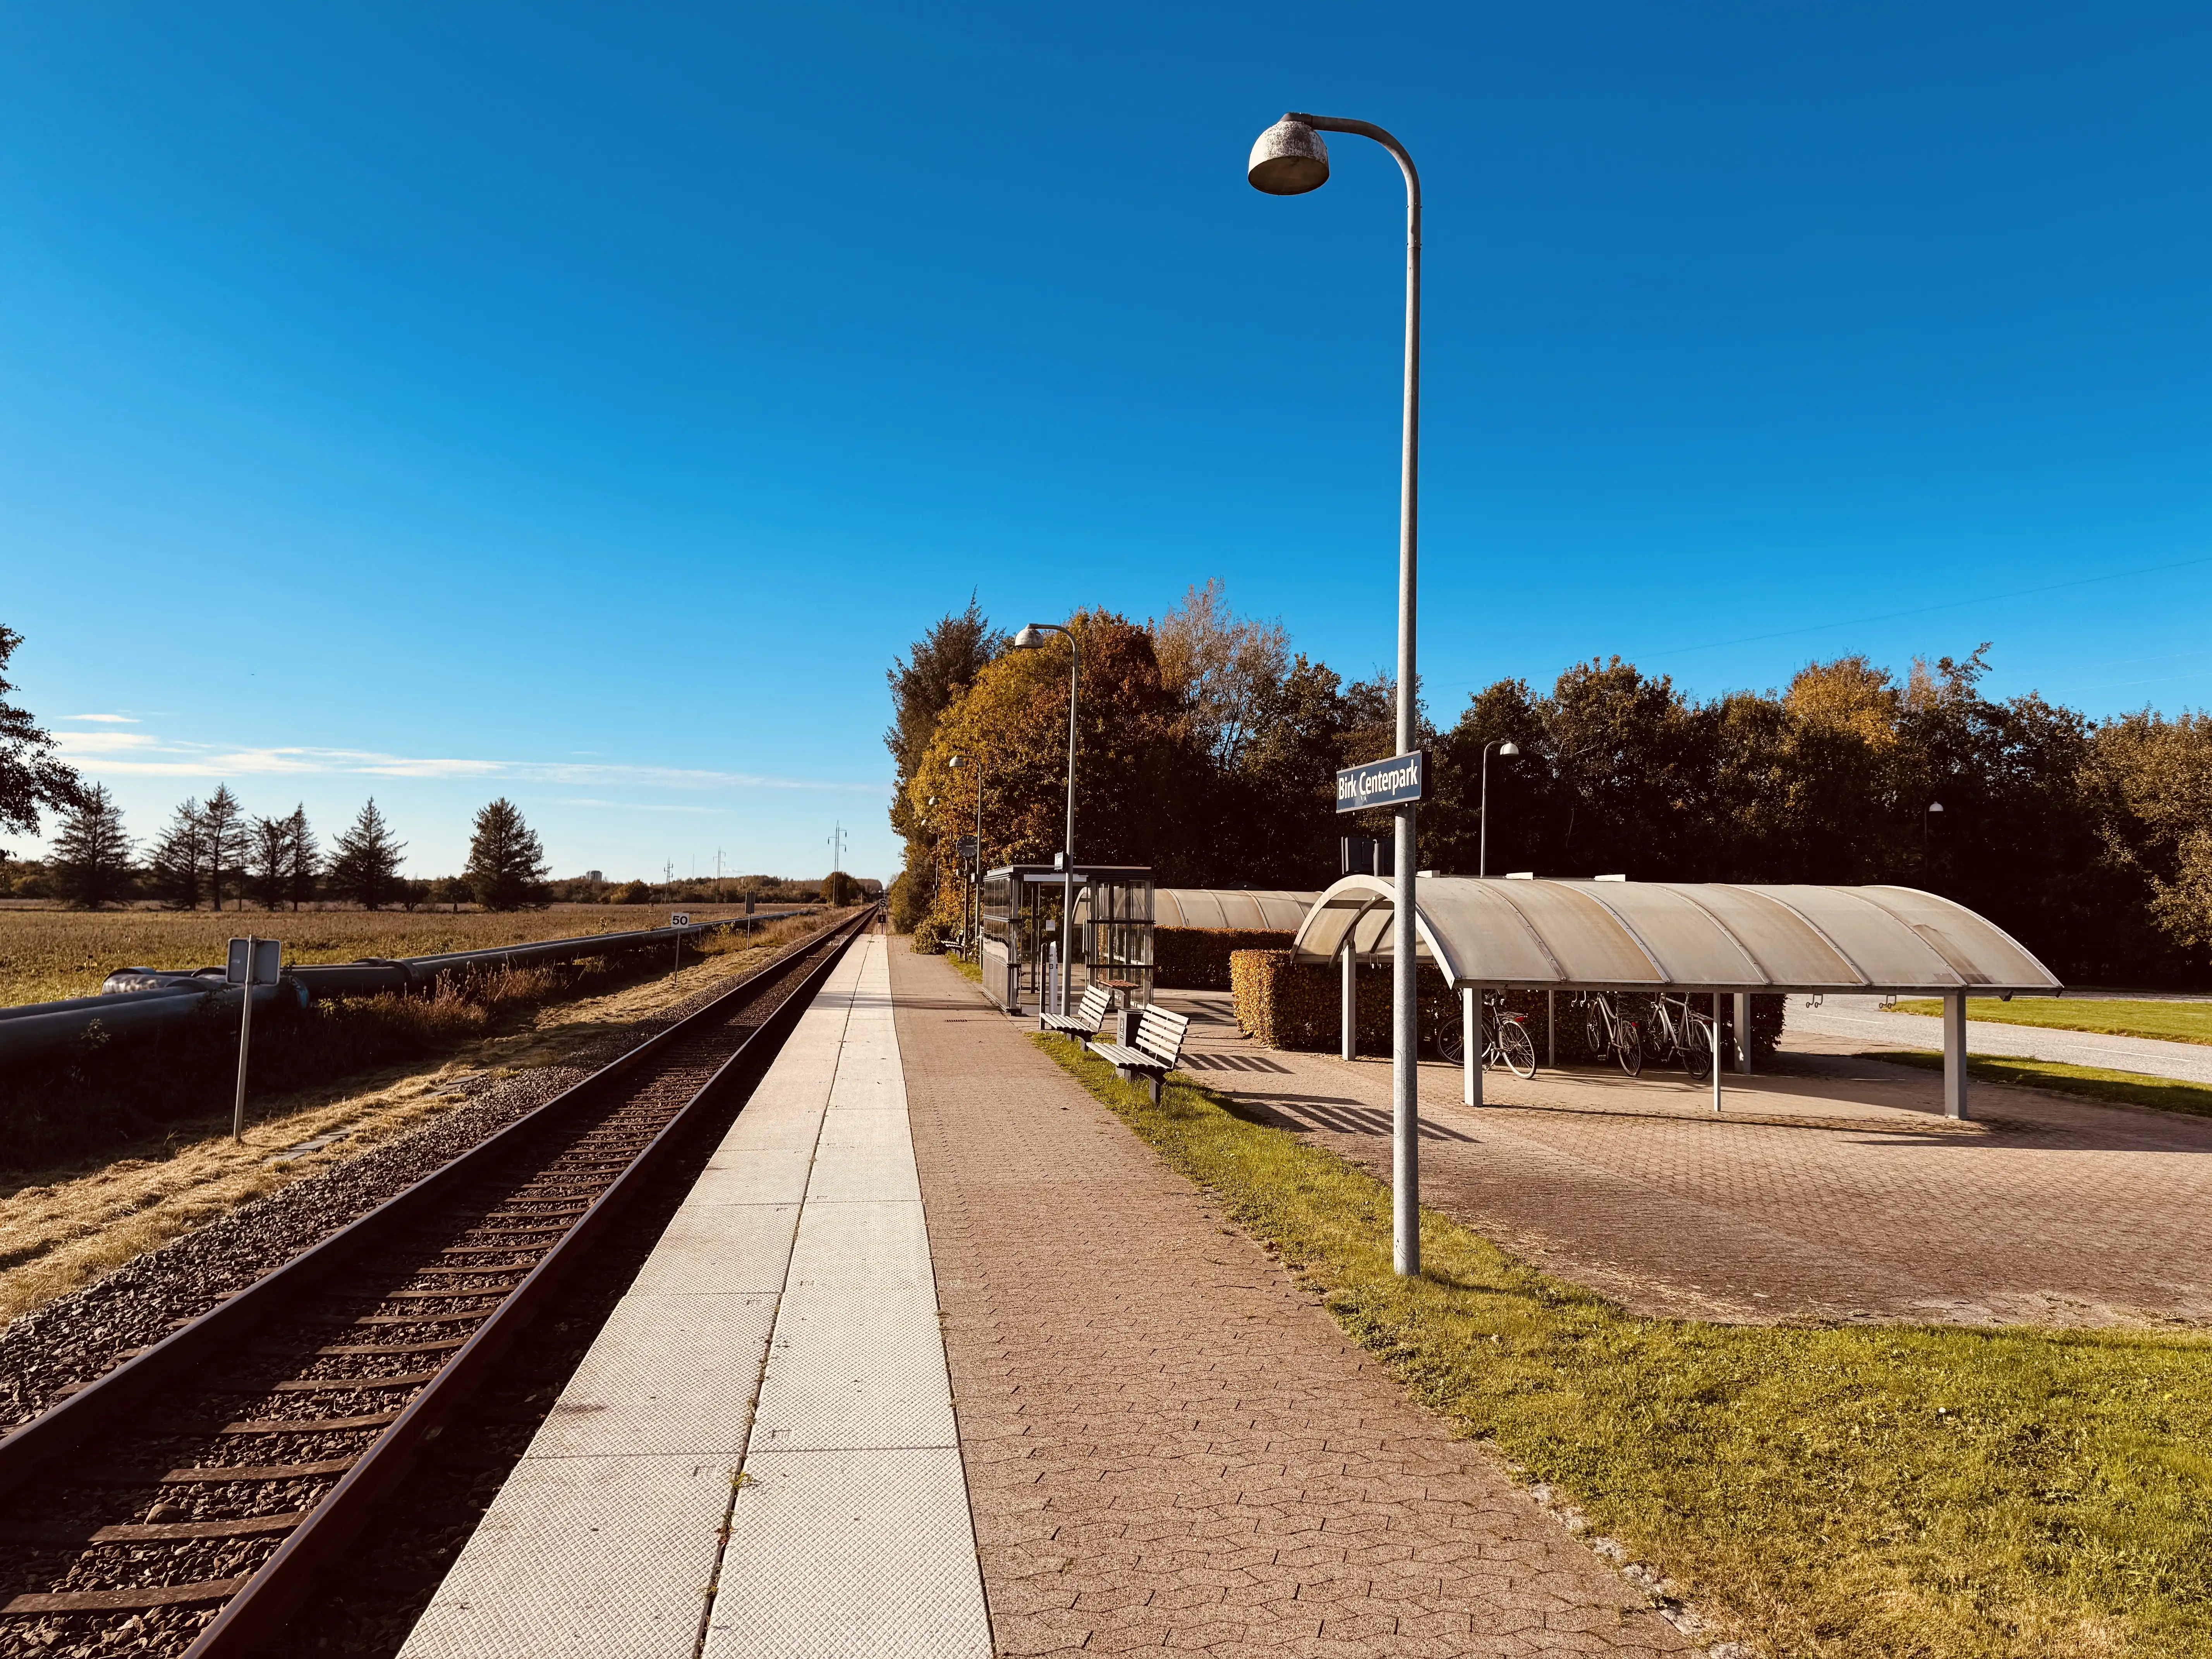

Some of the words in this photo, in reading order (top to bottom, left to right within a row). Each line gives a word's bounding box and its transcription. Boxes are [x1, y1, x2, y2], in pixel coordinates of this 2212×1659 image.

[1338, 774, 1357, 800] Birk
[1359, 759, 1418, 796] Centerpark
[672, 915, 688, 925] 50
